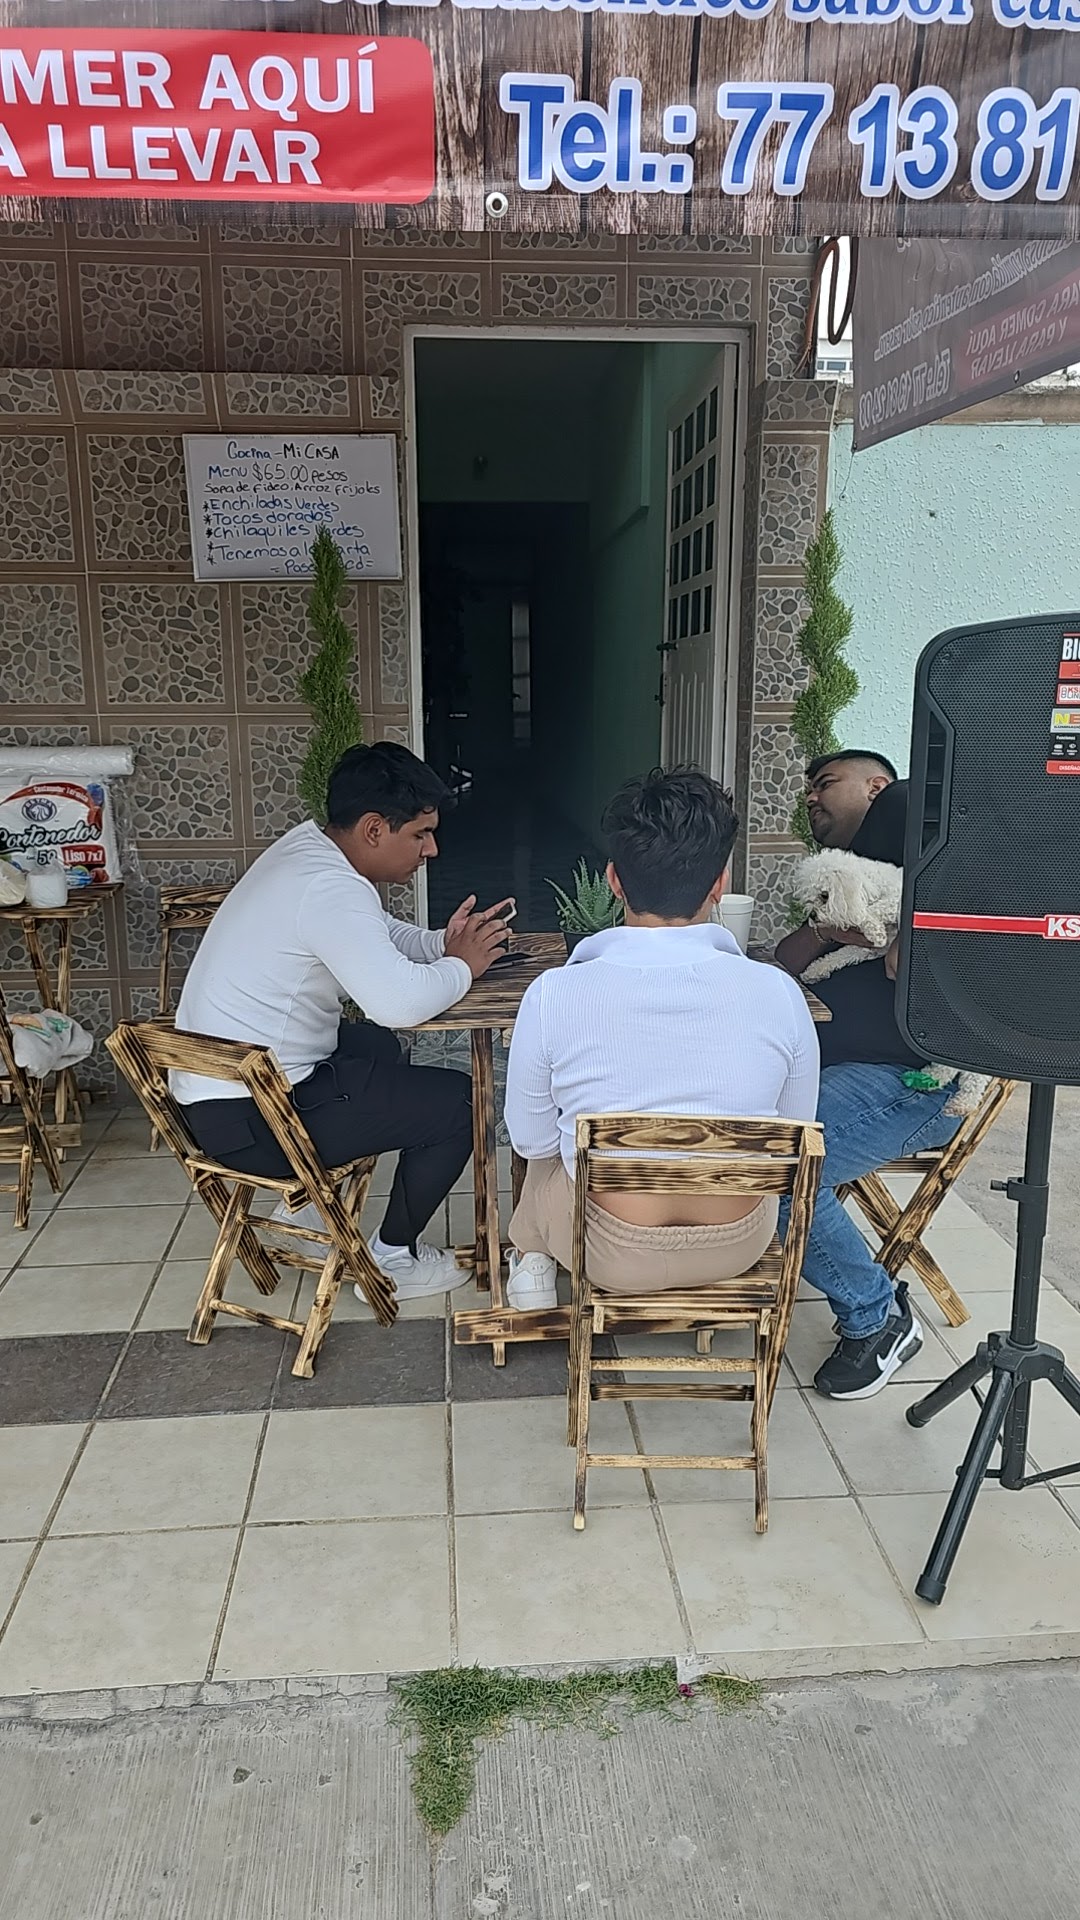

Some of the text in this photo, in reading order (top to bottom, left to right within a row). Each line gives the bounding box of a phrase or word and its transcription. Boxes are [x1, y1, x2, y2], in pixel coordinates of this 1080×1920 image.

[0, 41, 378, 122] MER AQUÍ
[503, 76, 1078, 198] Tel.: 77 13 81
[48, 124, 323, 185] LLEVAR
[208, 465, 248, 480] Menu
[252, 462, 308, 483] $65.00
[236, 481, 250, 492] de
[295, 483, 331, 493] Arroz
[266, 510, 334, 525] dorados
[336, 541, 371, 556] arta
[1062, 637, 1080, 660] BI
[86, 849, 104, 862] 7x7
